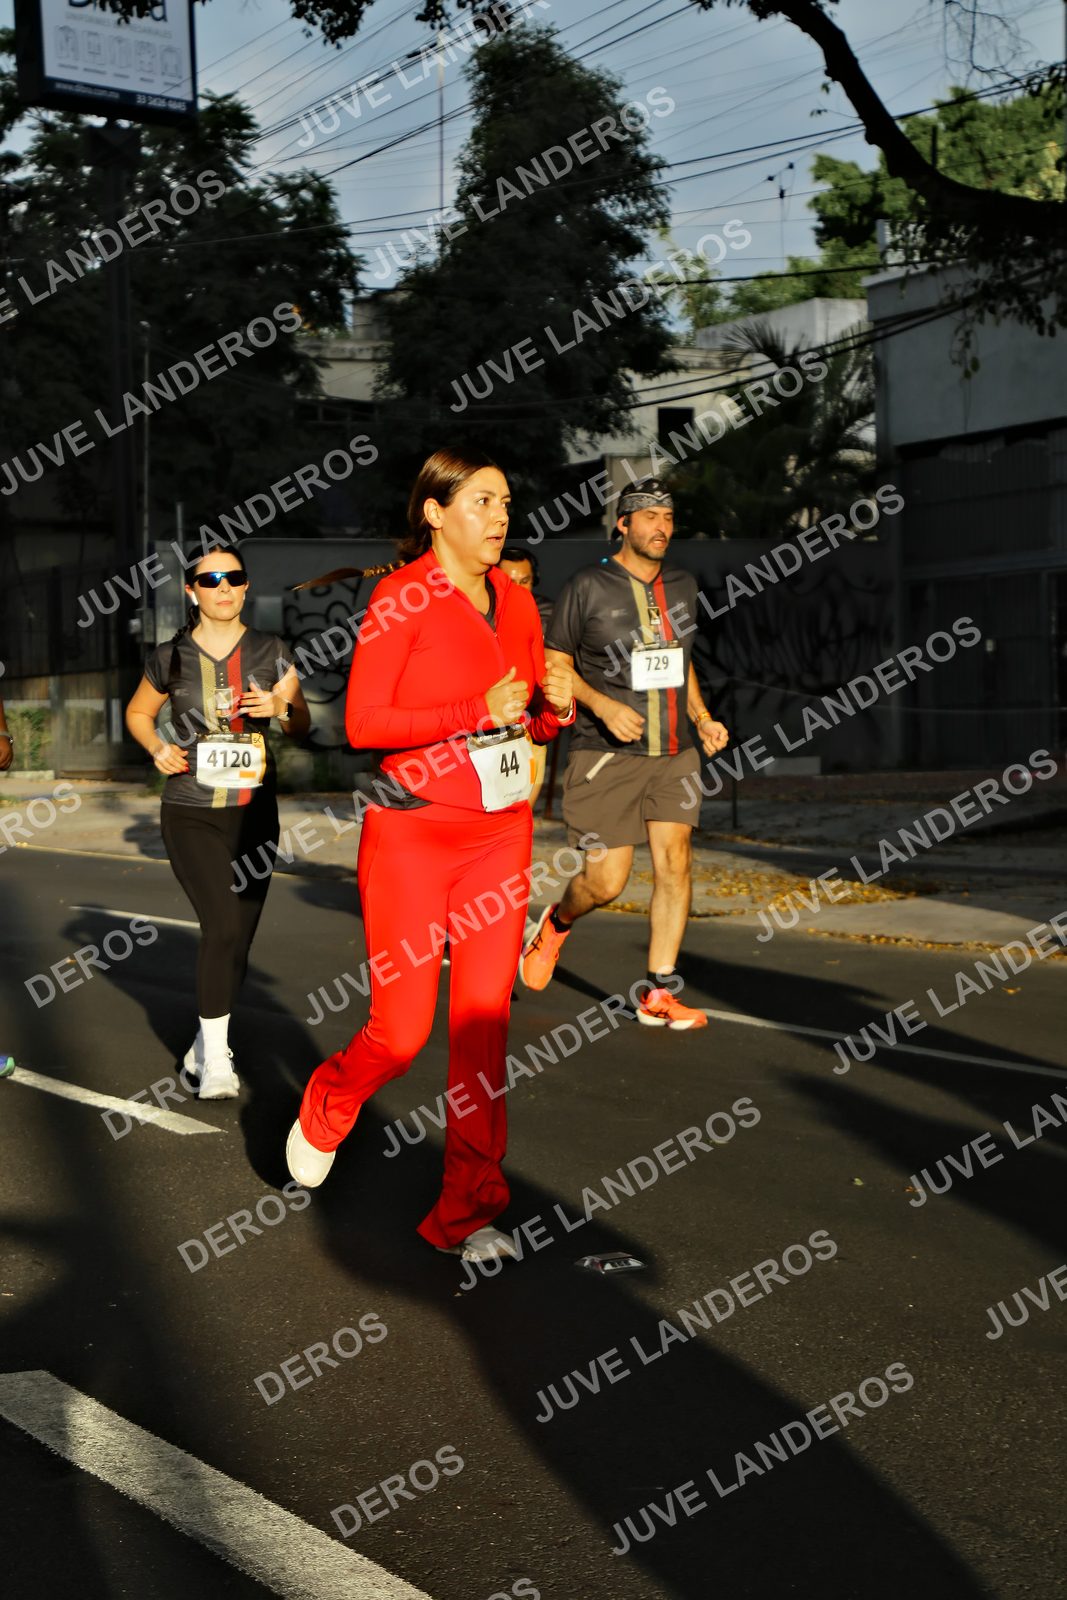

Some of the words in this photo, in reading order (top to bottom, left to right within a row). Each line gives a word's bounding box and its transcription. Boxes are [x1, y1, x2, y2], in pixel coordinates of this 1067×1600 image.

[645, 655, 669, 672] 729
[207, 749, 251, 768] 4120
[500, 750, 520, 777] 44
